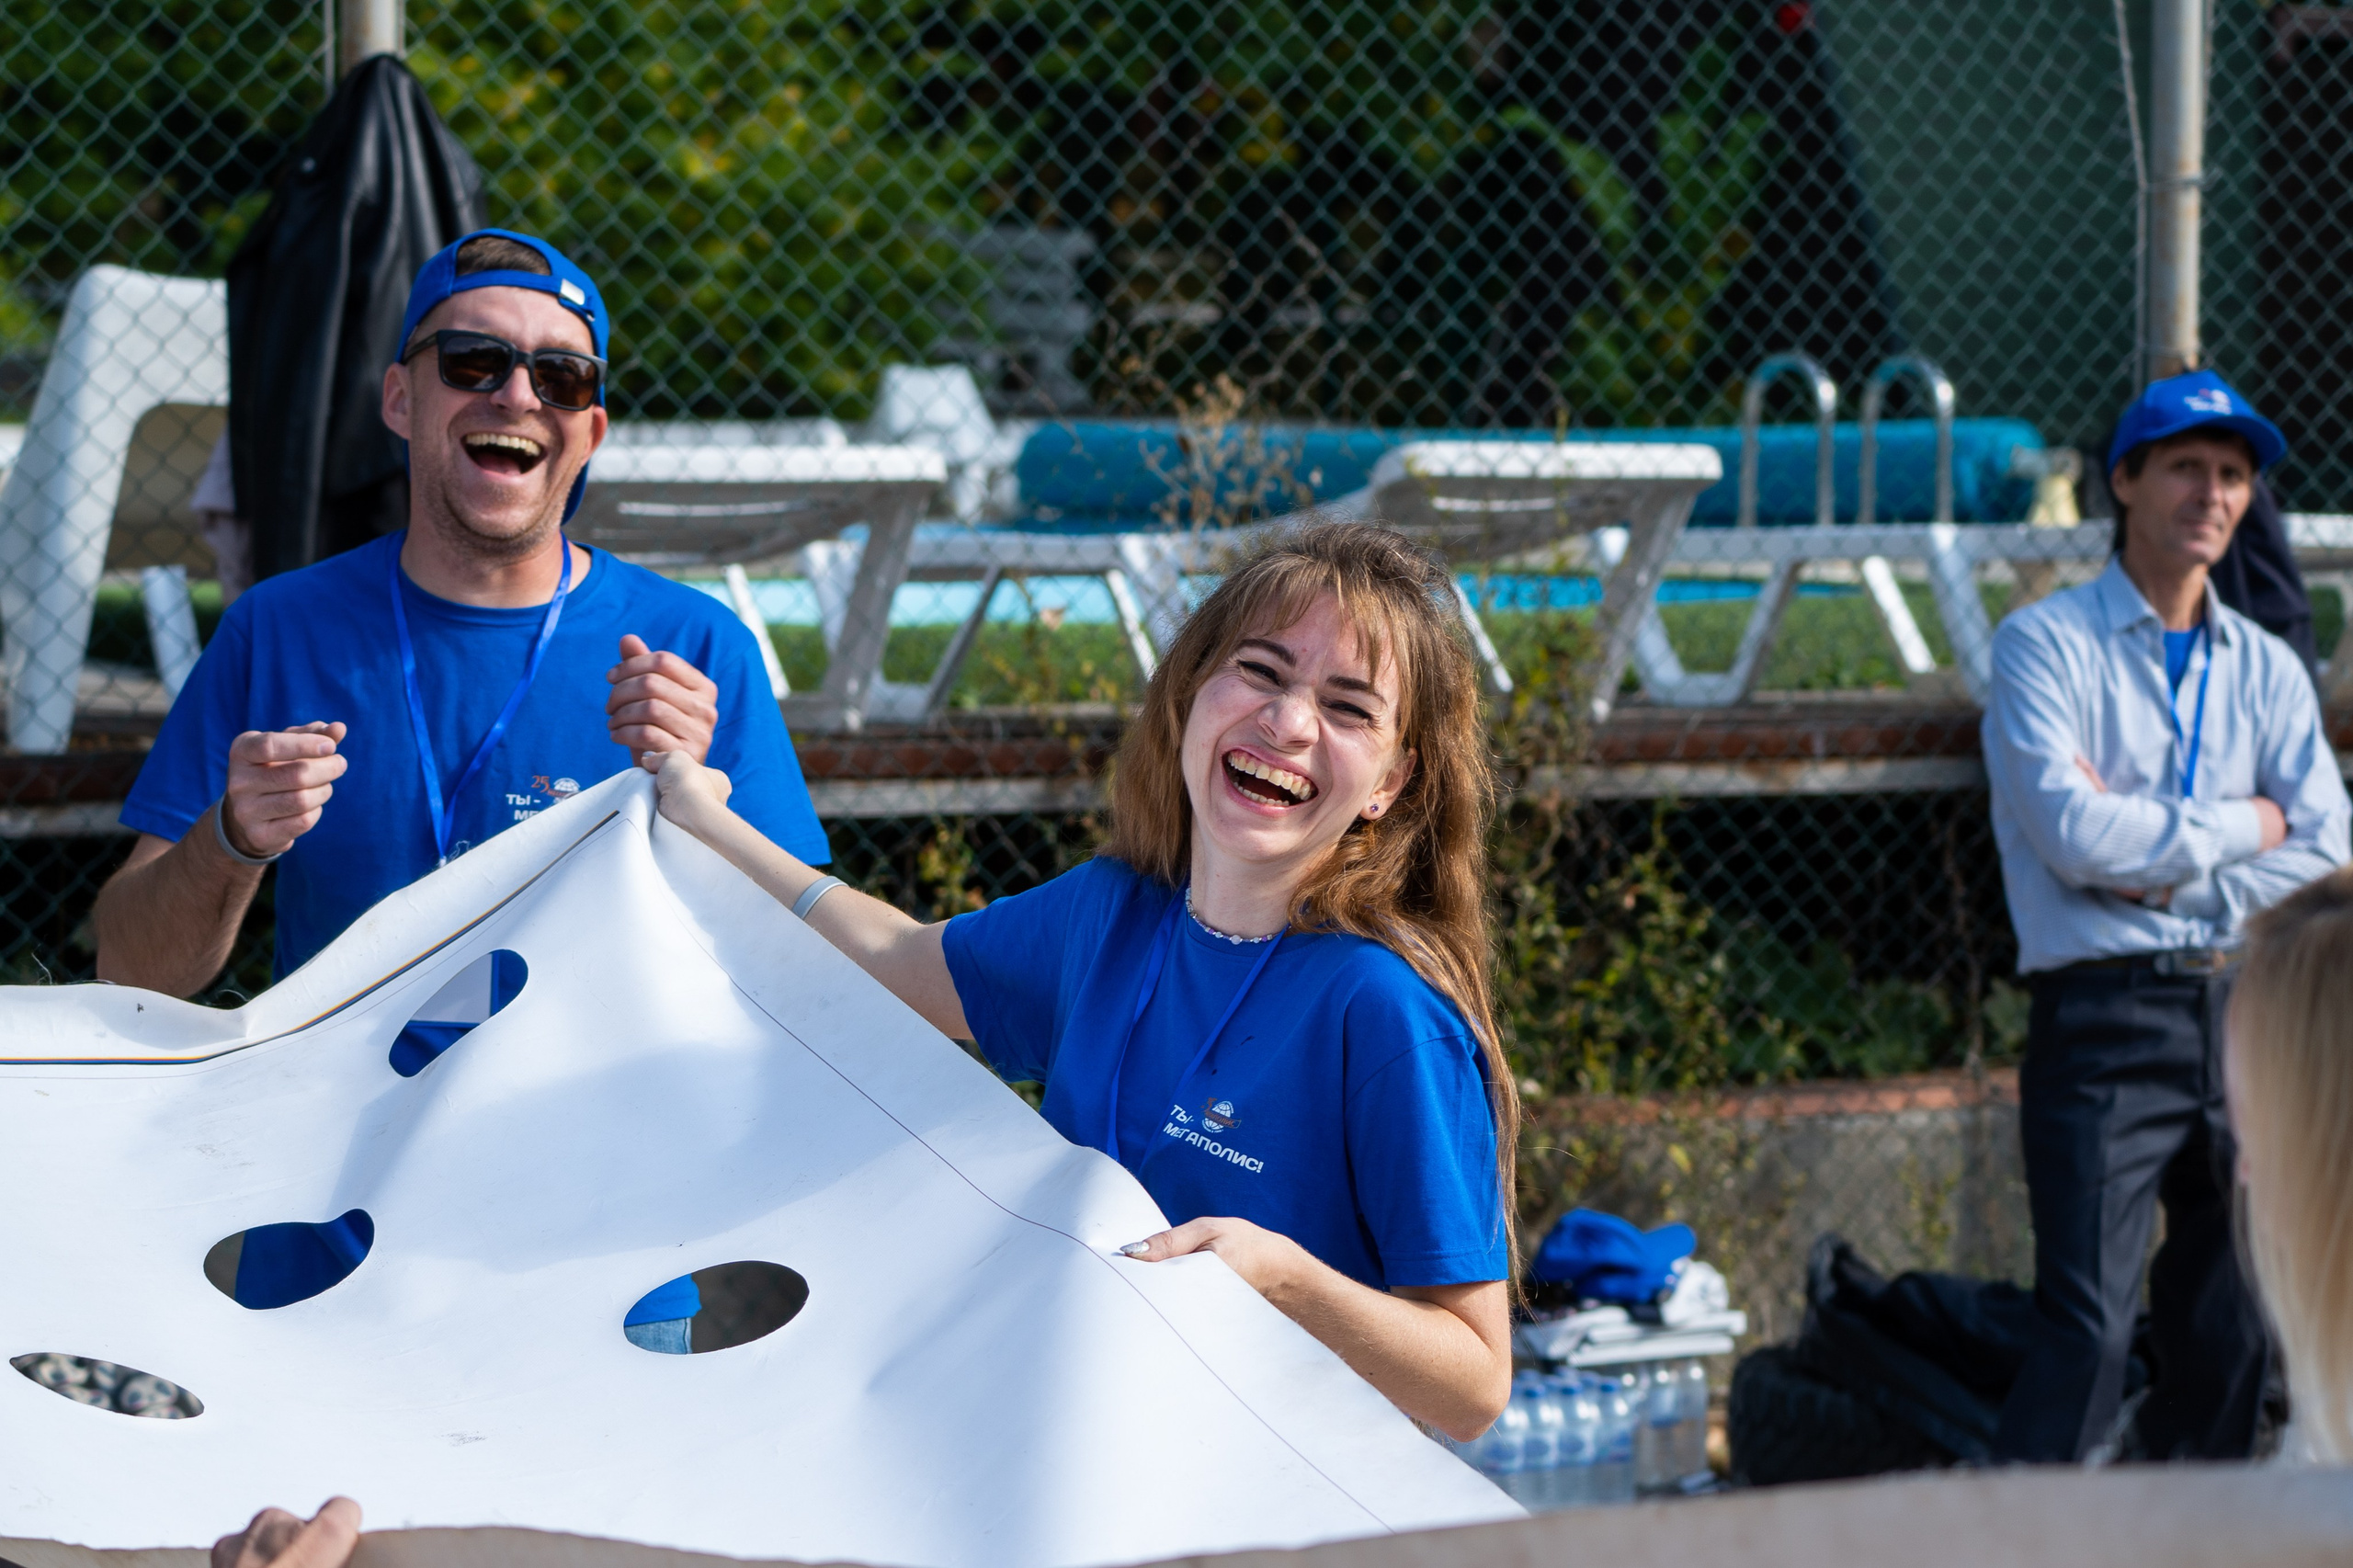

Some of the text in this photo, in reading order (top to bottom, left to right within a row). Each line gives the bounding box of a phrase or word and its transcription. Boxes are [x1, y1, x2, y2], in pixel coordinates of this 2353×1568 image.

[531, 775, 551, 793] 25
[506, 794, 531, 806] ТЫ
[1163, 1122, 1265, 1174] МЕГАПОЛИС!
